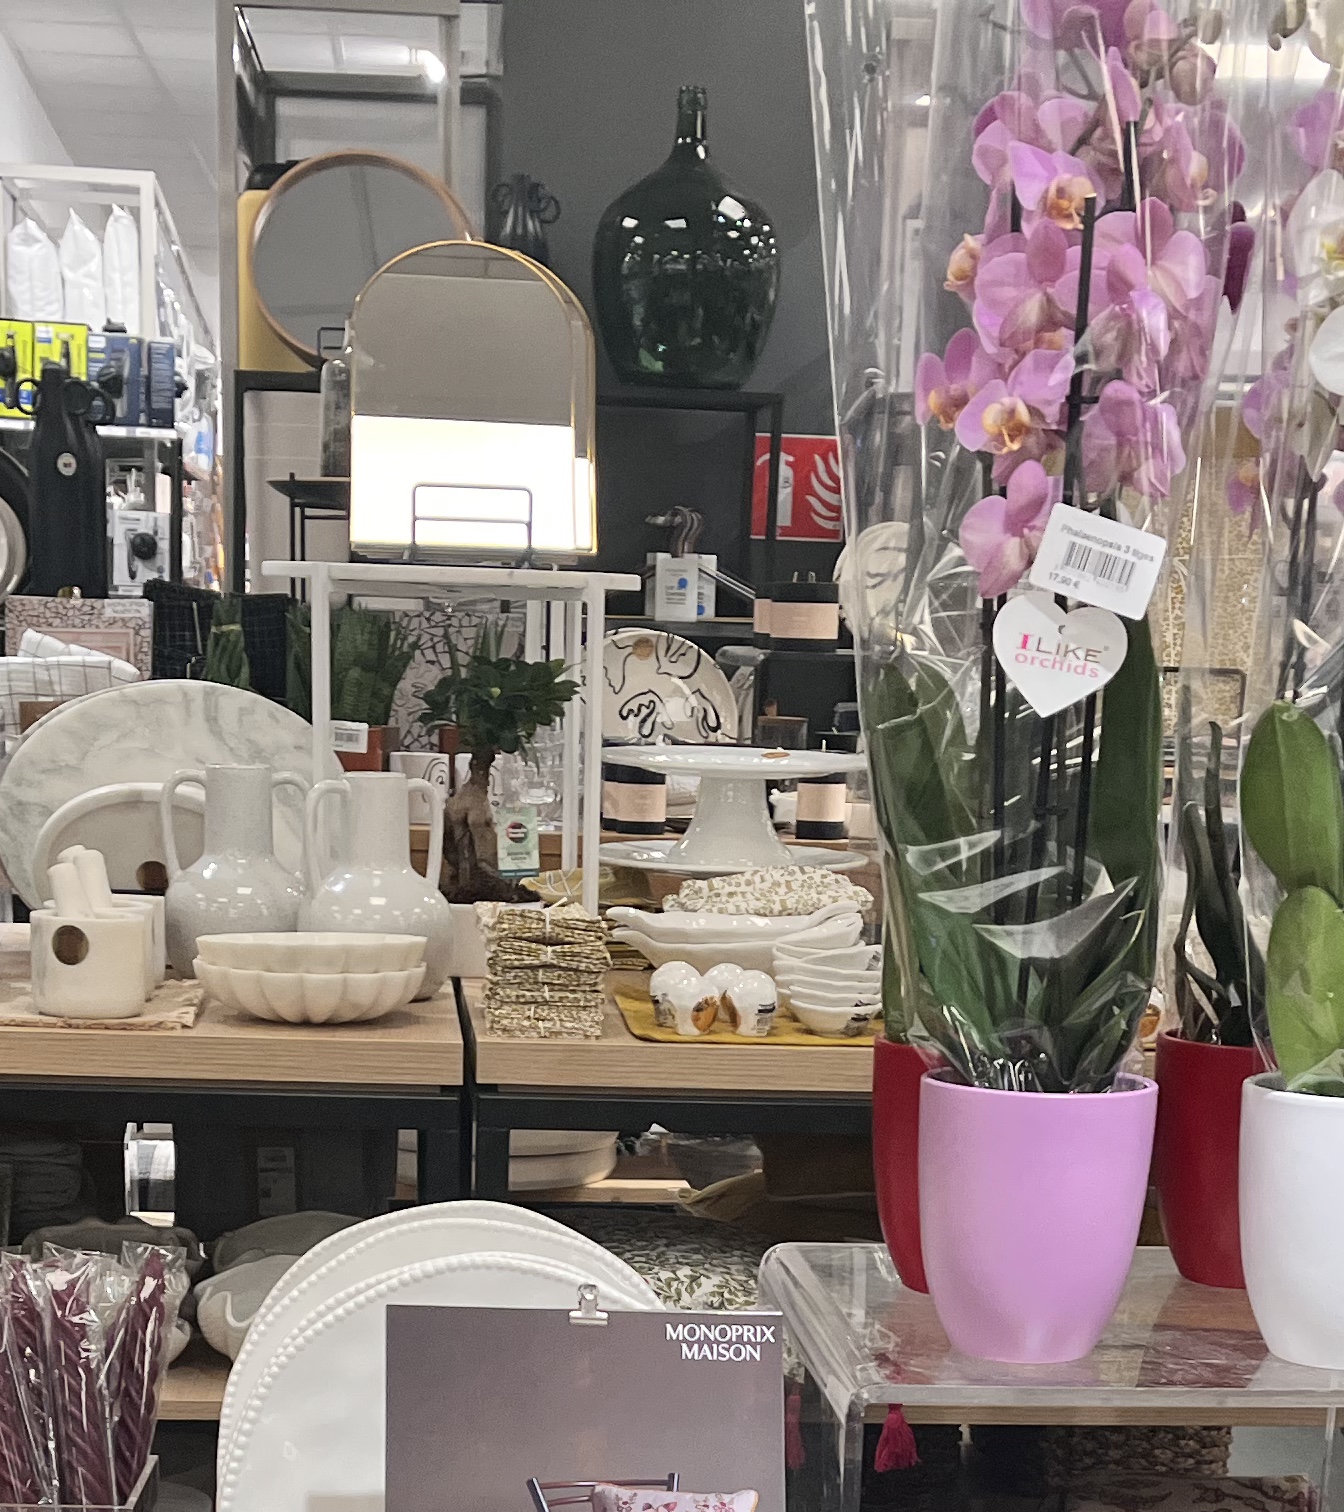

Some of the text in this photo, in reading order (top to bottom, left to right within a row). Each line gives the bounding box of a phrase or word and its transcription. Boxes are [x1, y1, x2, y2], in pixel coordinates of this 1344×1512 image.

[1015, 631, 1102, 664] I LIKE
[1014, 652, 1101, 678] orchids
[665, 1323, 776, 1343] MONOPRIX
[680, 1342, 762, 1361] MAISON
